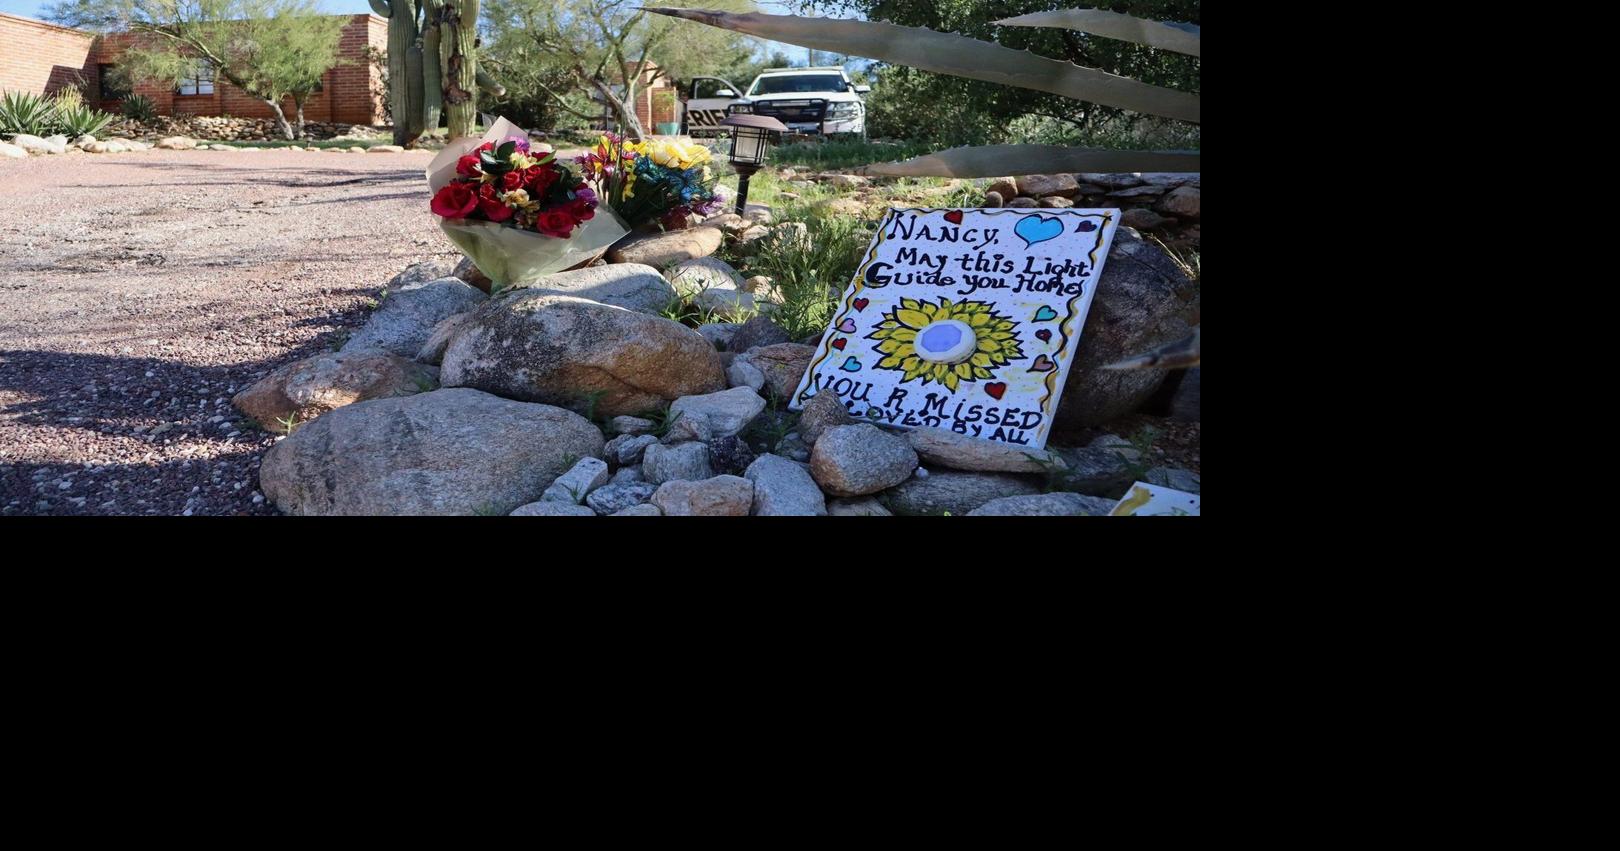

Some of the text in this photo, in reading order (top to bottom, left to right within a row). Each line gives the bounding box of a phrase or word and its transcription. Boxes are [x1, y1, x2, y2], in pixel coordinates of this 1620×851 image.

[861, 262, 1083, 296] Guide you Home
[954, 251, 1014, 273] this
[1022, 256, 1090, 281] Light
[883, 387, 908, 413] R
[988, 427, 1030, 445] ALL
